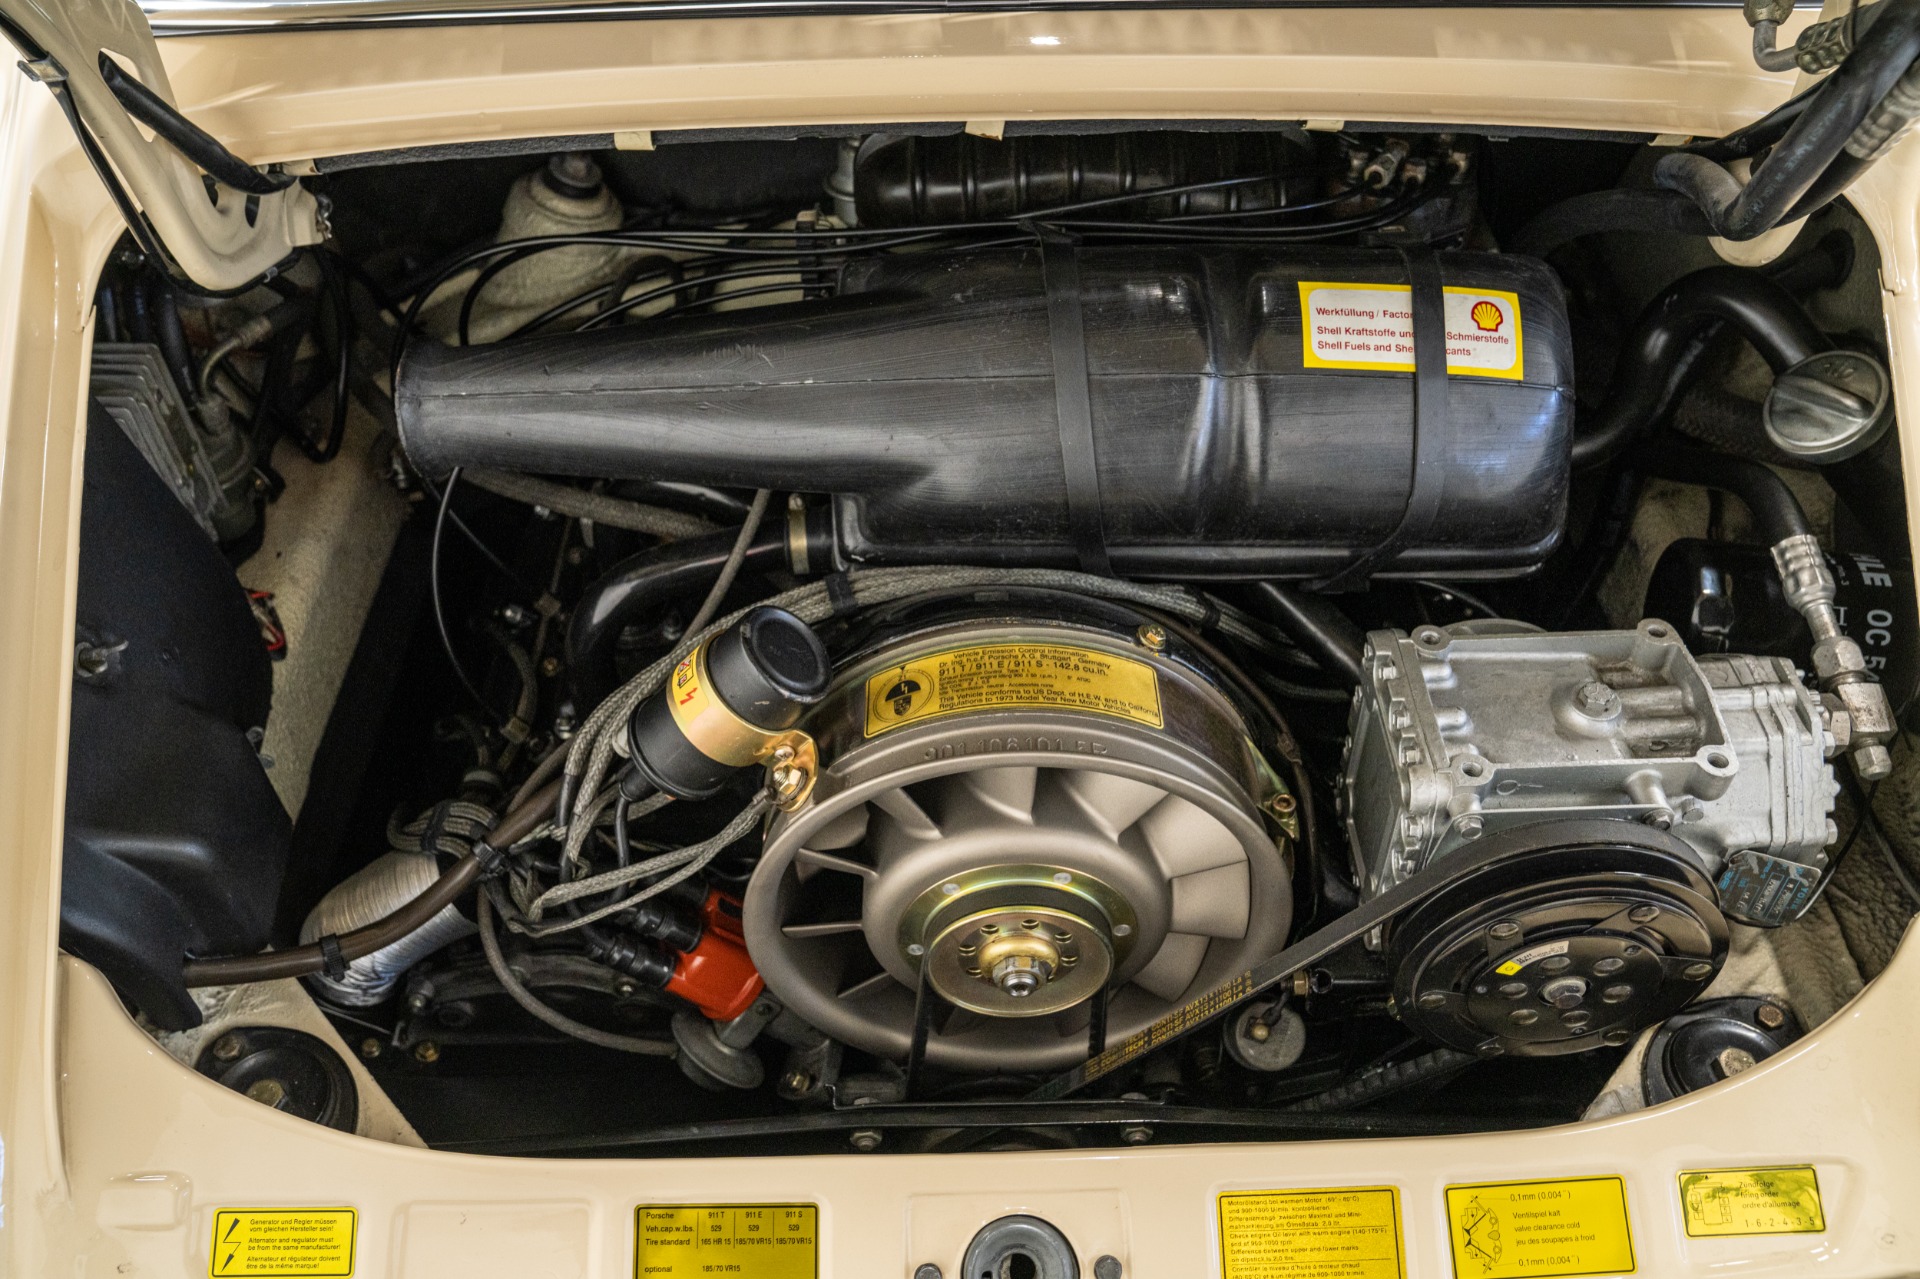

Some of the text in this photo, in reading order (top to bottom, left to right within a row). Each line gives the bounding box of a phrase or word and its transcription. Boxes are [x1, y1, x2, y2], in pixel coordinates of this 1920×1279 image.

[1316, 307, 1374, 320] Werkfüllung
[1317, 326, 1341, 336] Shell
[1345, 327, 1395, 338] Kraftstoffe
[1447, 332, 1509, 345] Schmierstoffe
[1318, 341, 1342, 350] Shell
[1345, 342, 1371, 351] Fuels
[1374, 344, 1391, 352] and
[954, 646, 1089, 659] Vehicle Emission Control Information
[988, 653, 1019, 661] Porsche
[1040, 653, 1072, 662] Stuttgart
[1078, 657, 1111, 669] Germany
[939, 666, 956, 677] 911
[961, 663, 968, 673] T
[976, 661, 994, 671] 911
[997, 660, 1005, 669] E
[1014, 660, 1032, 668] 911
[1036, 660, 1044, 668] S
[939, 698, 984, 710] Regulations
[1016, 694, 1040, 702] Model
[1042, 694, 1059, 702] Year
[1060, 696, 1077, 705] New
[1079, 698, 1100, 708] Motor
[1101, 702, 1131, 715] Vehicles
[940, 696, 954, 704] This
[956, 691, 983, 701] Vehicle
[985, 689, 1021, 697] conforms
[1033, 688, 1045, 696] US
[1047, 689, 1066, 697] Dept.
[1069, 690, 1077, 698] of
[1104, 697, 1118, 705] and
[1119, 699, 1127, 708] to
[1128, 702, 1159, 718] California
[1760, 1190, 1780, 1199] order
[1742, 1200, 1801, 1209] ordre d'allumage
[646, 1211, 675, 1219] Porsche
[707, 1211, 725, 1219] 911 T
[745, 1211, 763, 1219] 911 E
[797, 1210, 803, 1218] S
[1512, 1210, 1547, 1220] Ventilspiel
[293, 1218, 314, 1226] Regler
[314, 1217, 338, 1225] müssen
[264, 1225, 289, 1233] gleichen
[710, 1224, 722, 1232] 529
[748, 1224, 760, 1232] 529
[788, 1224, 800, 1232] 529
[1514, 1221, 1581, 1232] valve clearance cold
[1330, 1229, 1351, 1237] engine
[291, 1237, 318, 1245] regulator
[646, 1238, 691, 1246] Tire standard
[701, 1238, 712, 1246] 165
[756, 1237, 772, 1245] VR15
[796, 1237, 813, 1245] VR15
[1515, 1238, 1526, 1247] jeu
[1527, 1236, 1540, 1245] des
[1541, 1235, 1574, 1245] soupapes
[287, 1255, 318, 1264] régulateur
[295, 1262, 320, 1271] marque!
[644, 1265, 673, 1275] optional
[724, 1264, 741, 1272] VR15
